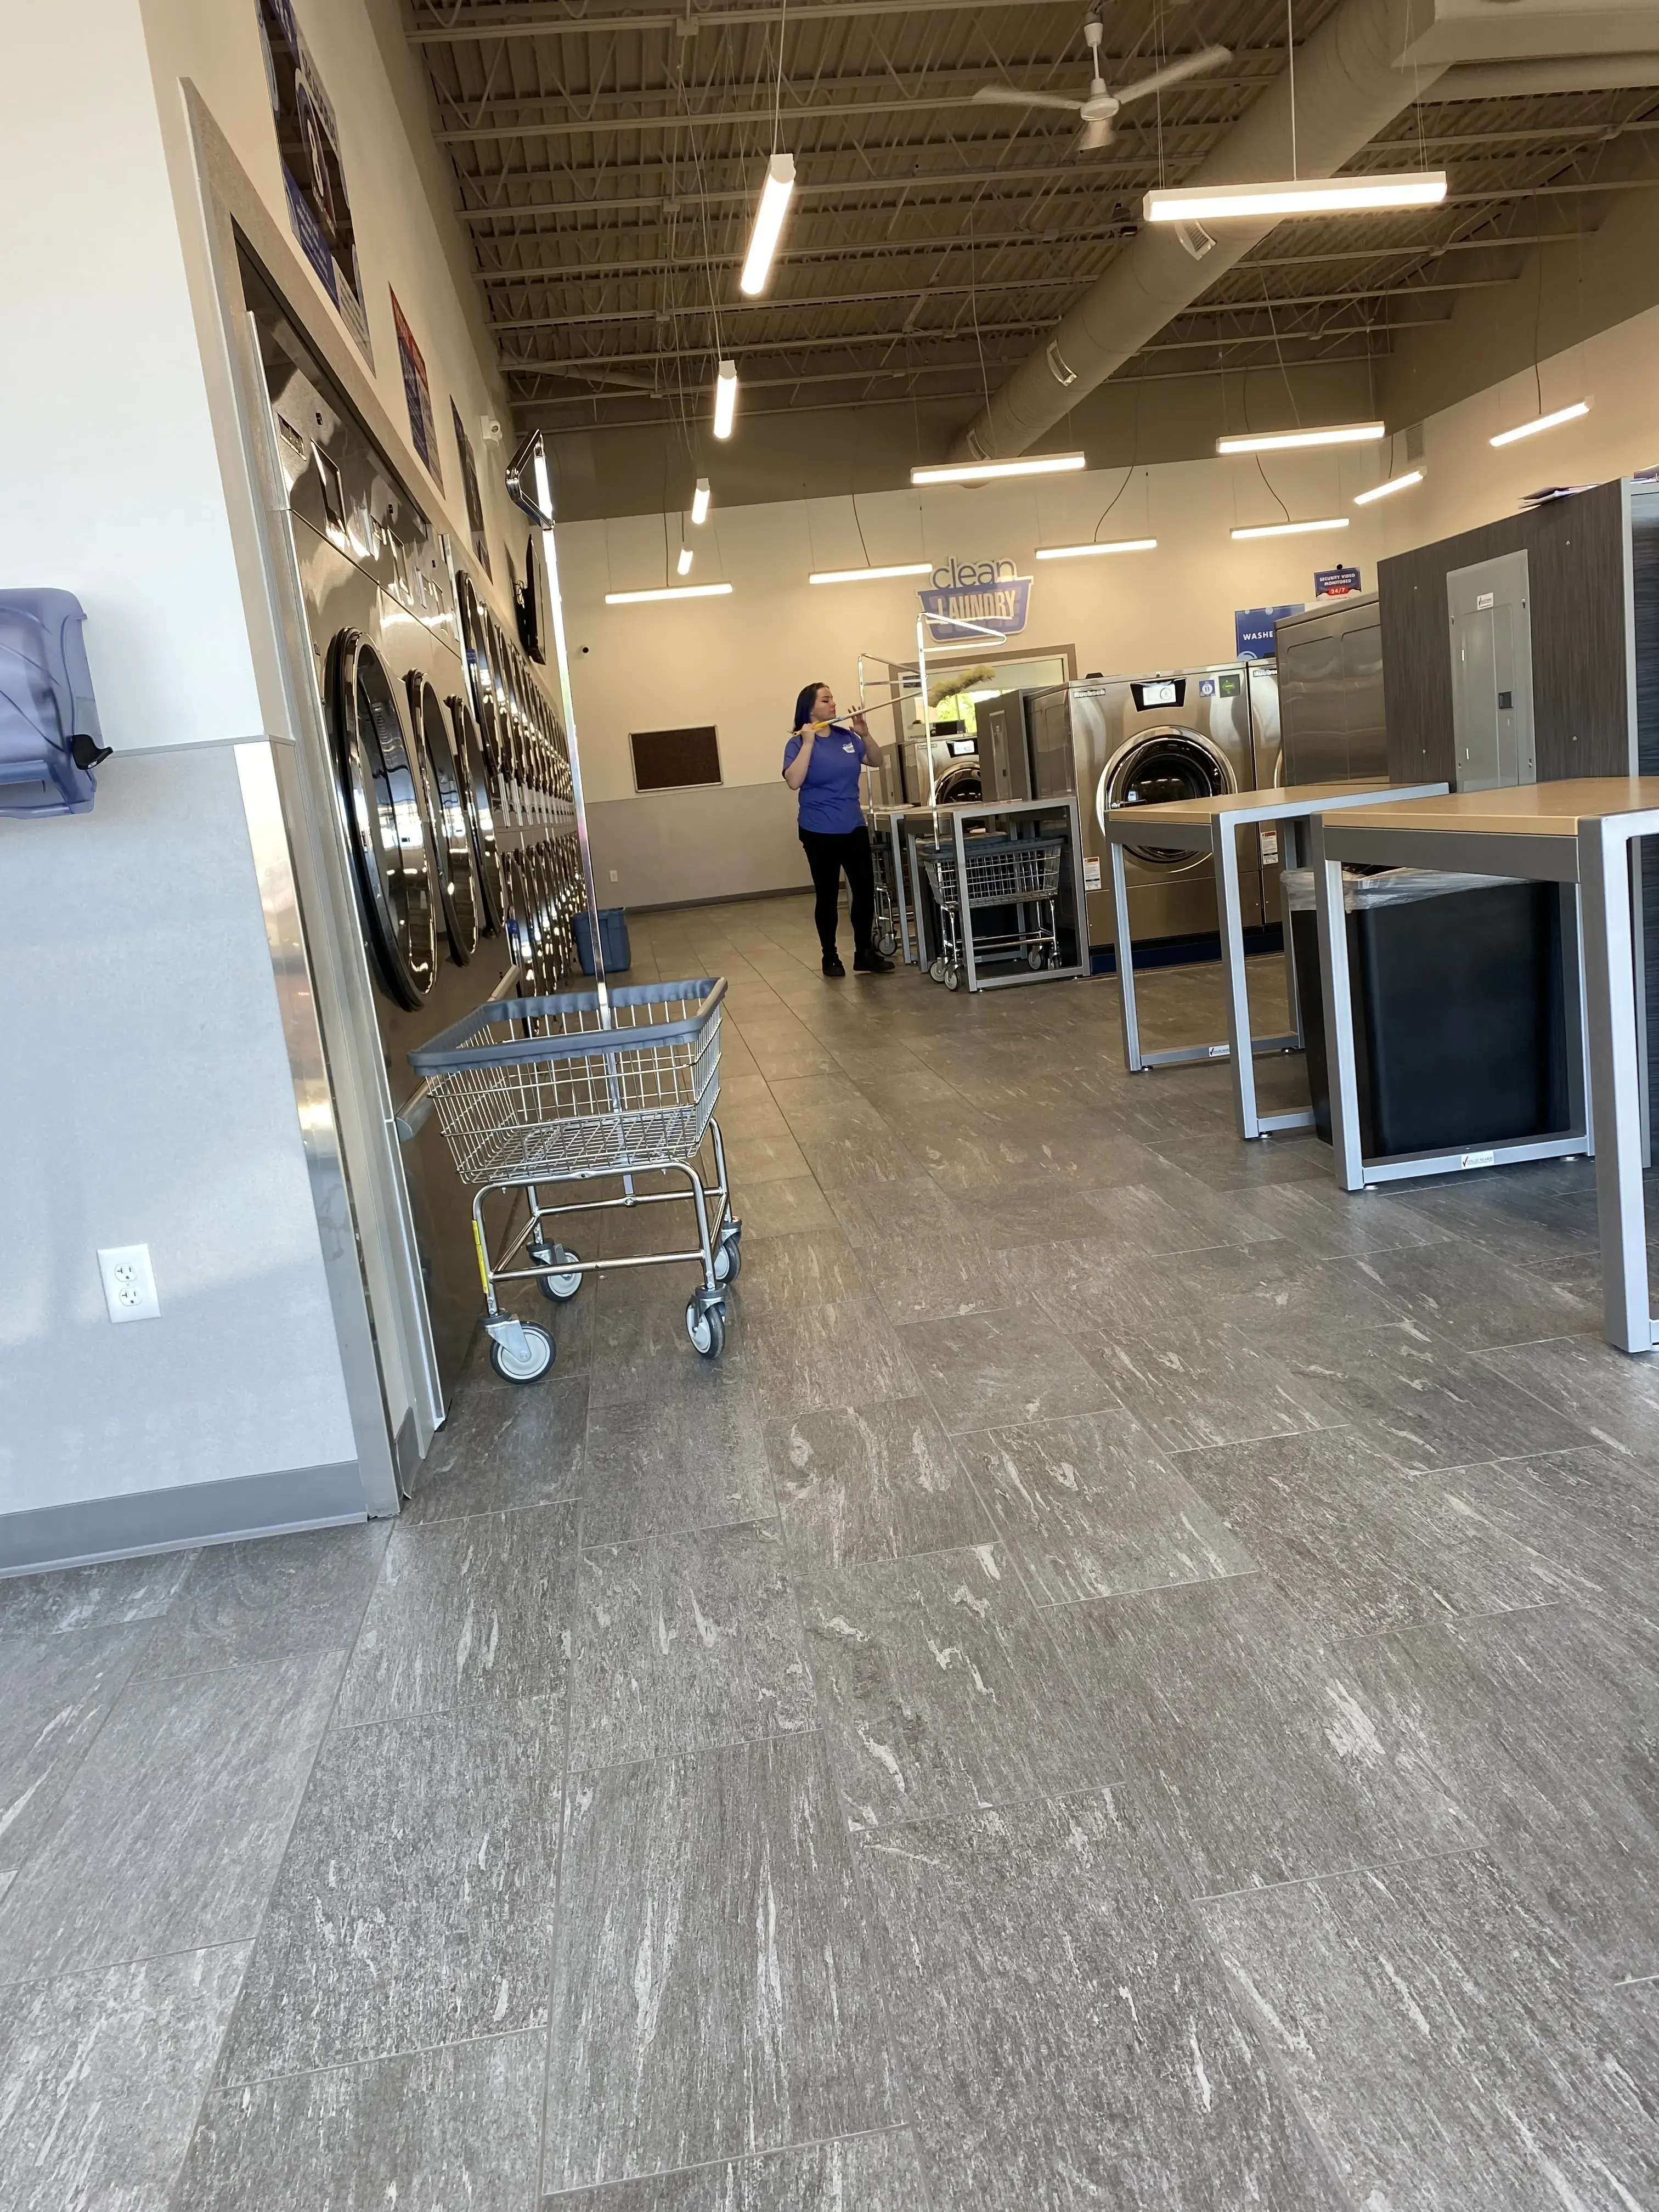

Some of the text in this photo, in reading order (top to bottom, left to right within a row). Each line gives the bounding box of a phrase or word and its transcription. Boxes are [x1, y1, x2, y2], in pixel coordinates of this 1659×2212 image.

[932, 558, 1014, 589] clean
[937, 590, 1015, 624] LAUNDRY
[1243, 630, 1273, 640] WASHE
